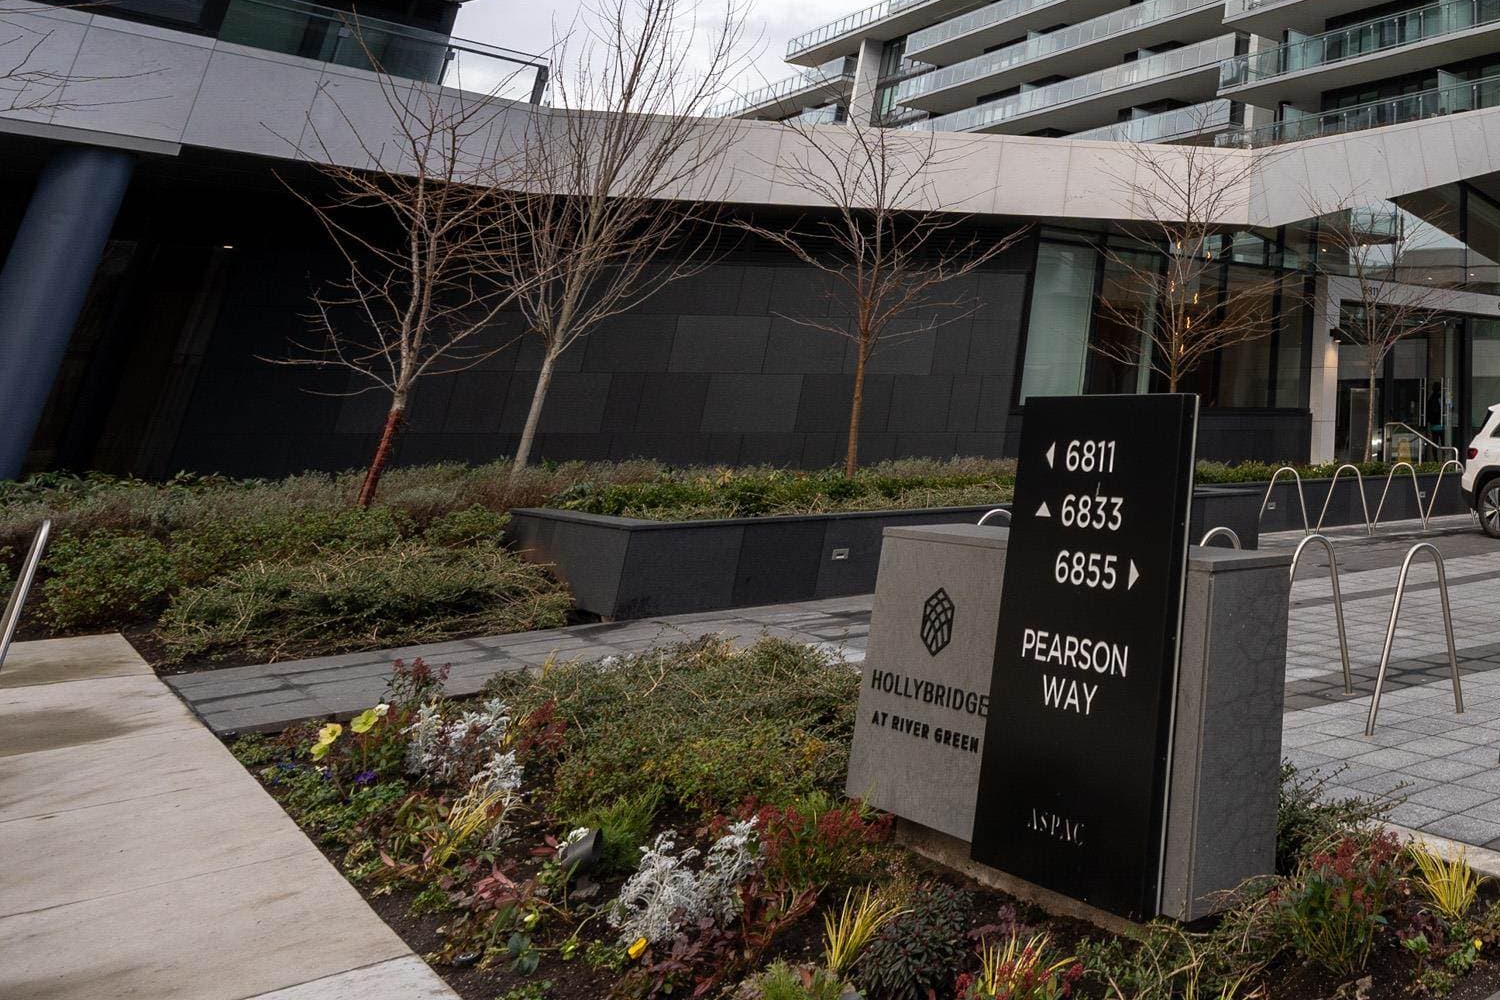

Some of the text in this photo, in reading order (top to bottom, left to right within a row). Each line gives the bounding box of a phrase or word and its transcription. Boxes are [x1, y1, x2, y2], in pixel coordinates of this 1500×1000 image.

[1065, 439, 1117, 473] 6811
[1061, 494, 1124, 531] 6833
[1055, 549, 1118, 590] 6855
[1021, 628, 1129, 678] PEARSON
[871, 669, 991, 718] HOLLYBRIDGE
[1043, 674, 1099, 716] WAY
[871, 710, 980, 754] AT RIVER GREEN
[1027, 807, 1085, 846] ASPAC
